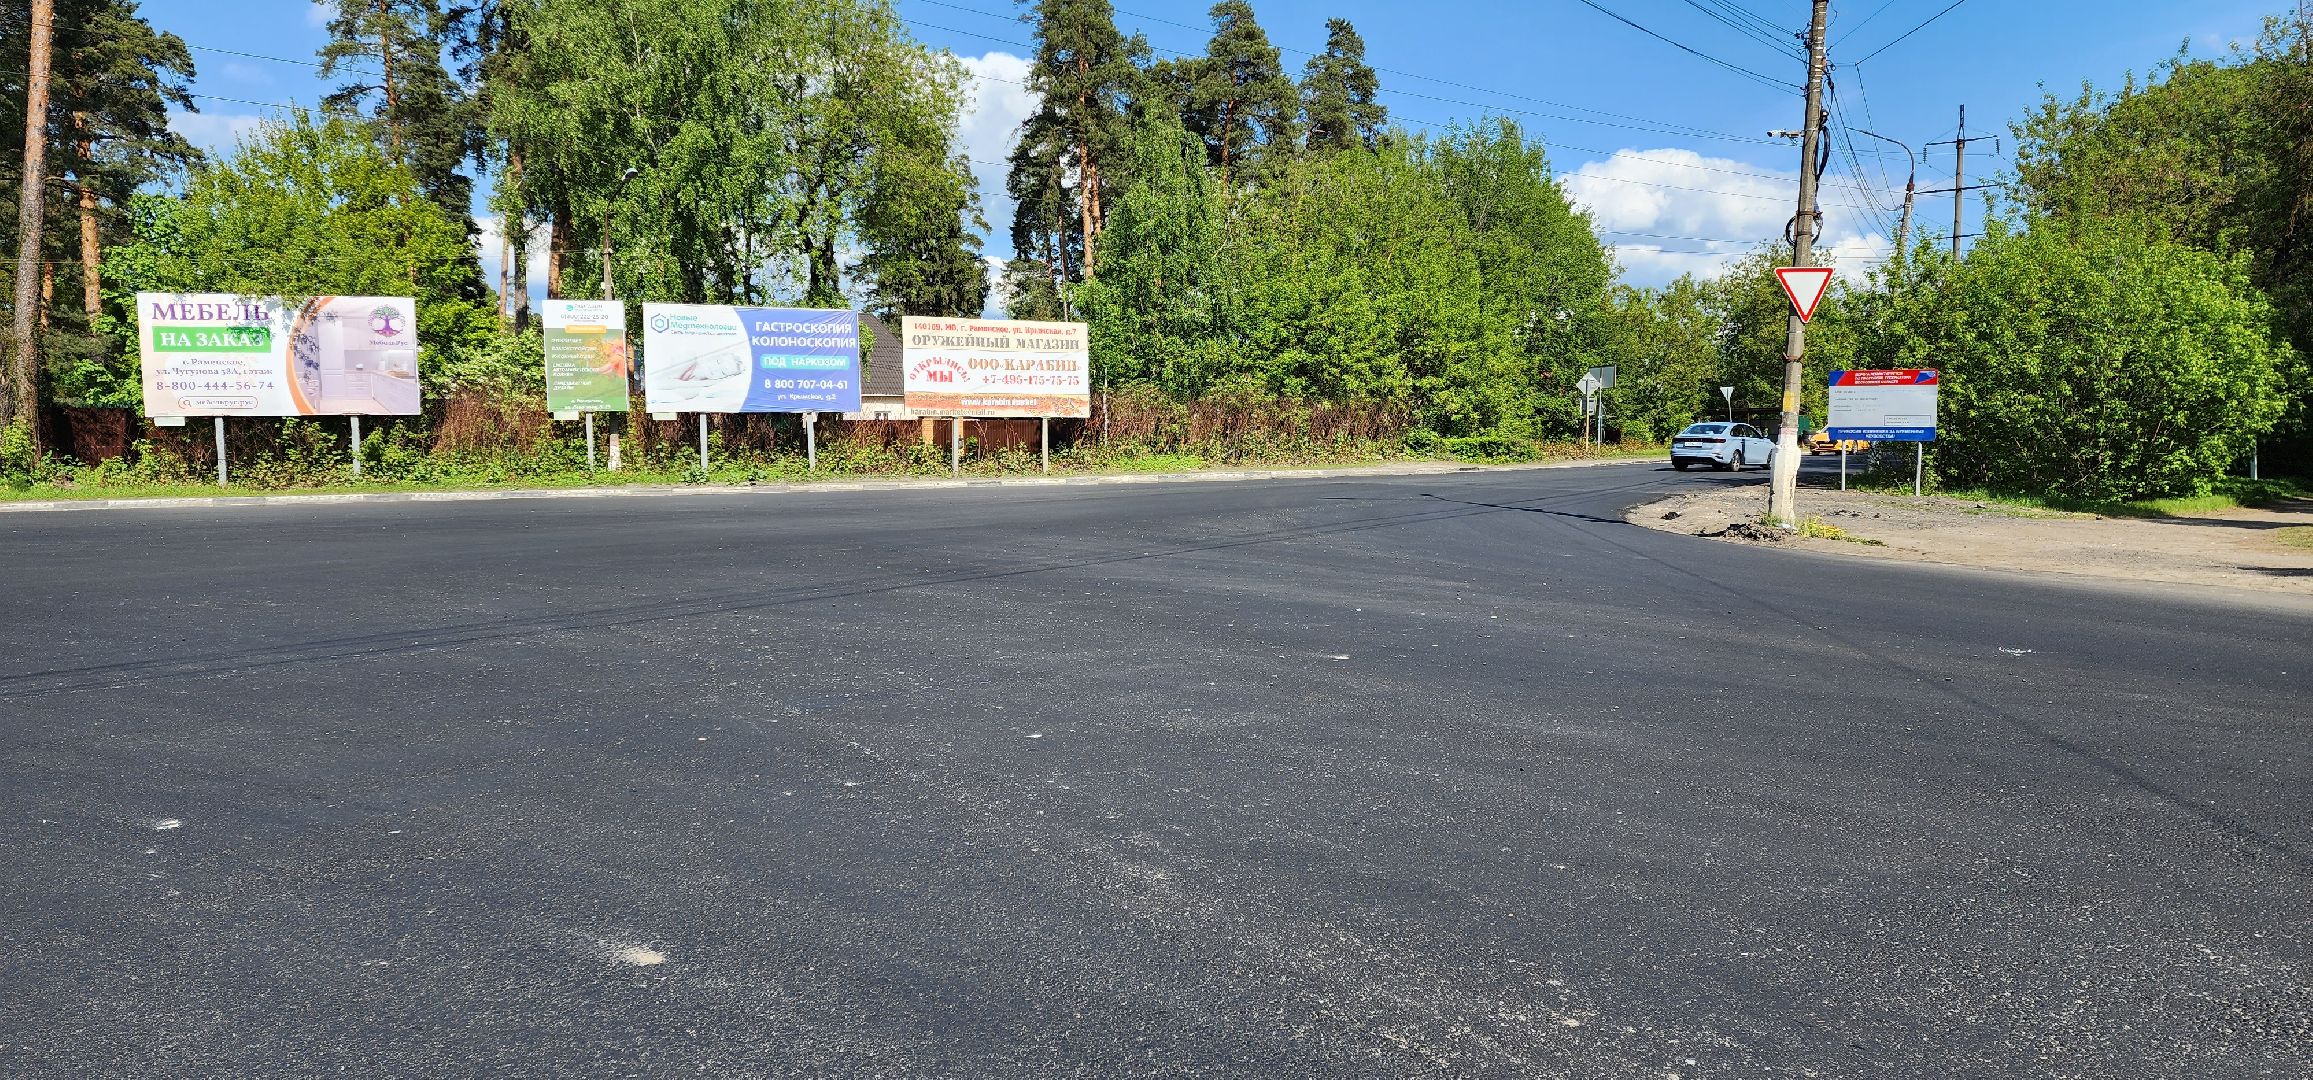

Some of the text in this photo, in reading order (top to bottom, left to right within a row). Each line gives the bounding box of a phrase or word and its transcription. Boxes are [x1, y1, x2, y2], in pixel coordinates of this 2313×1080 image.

[152, 303, 269, 320] МЕБЕЛЬ
[755, 321, 852, 335] ГАСТРОСКОПИЯ
[160, 332, 265, 347] НА ЗАКАЗ
[751, 336, 856, 349] КОЛОНОСКОПИЯ
[911, 333, 1080, 350] ОРУЖЕЙНЫЙ МАГАЗИН
[763, 356, 847, 368] ПОД НАРКОЗОМ
[927, 370, 953, 383] МЫ
[156, 381, 275, 391] 8-800-444-56-74
[764, 379, 848, 390] 8 800 707-04-61
